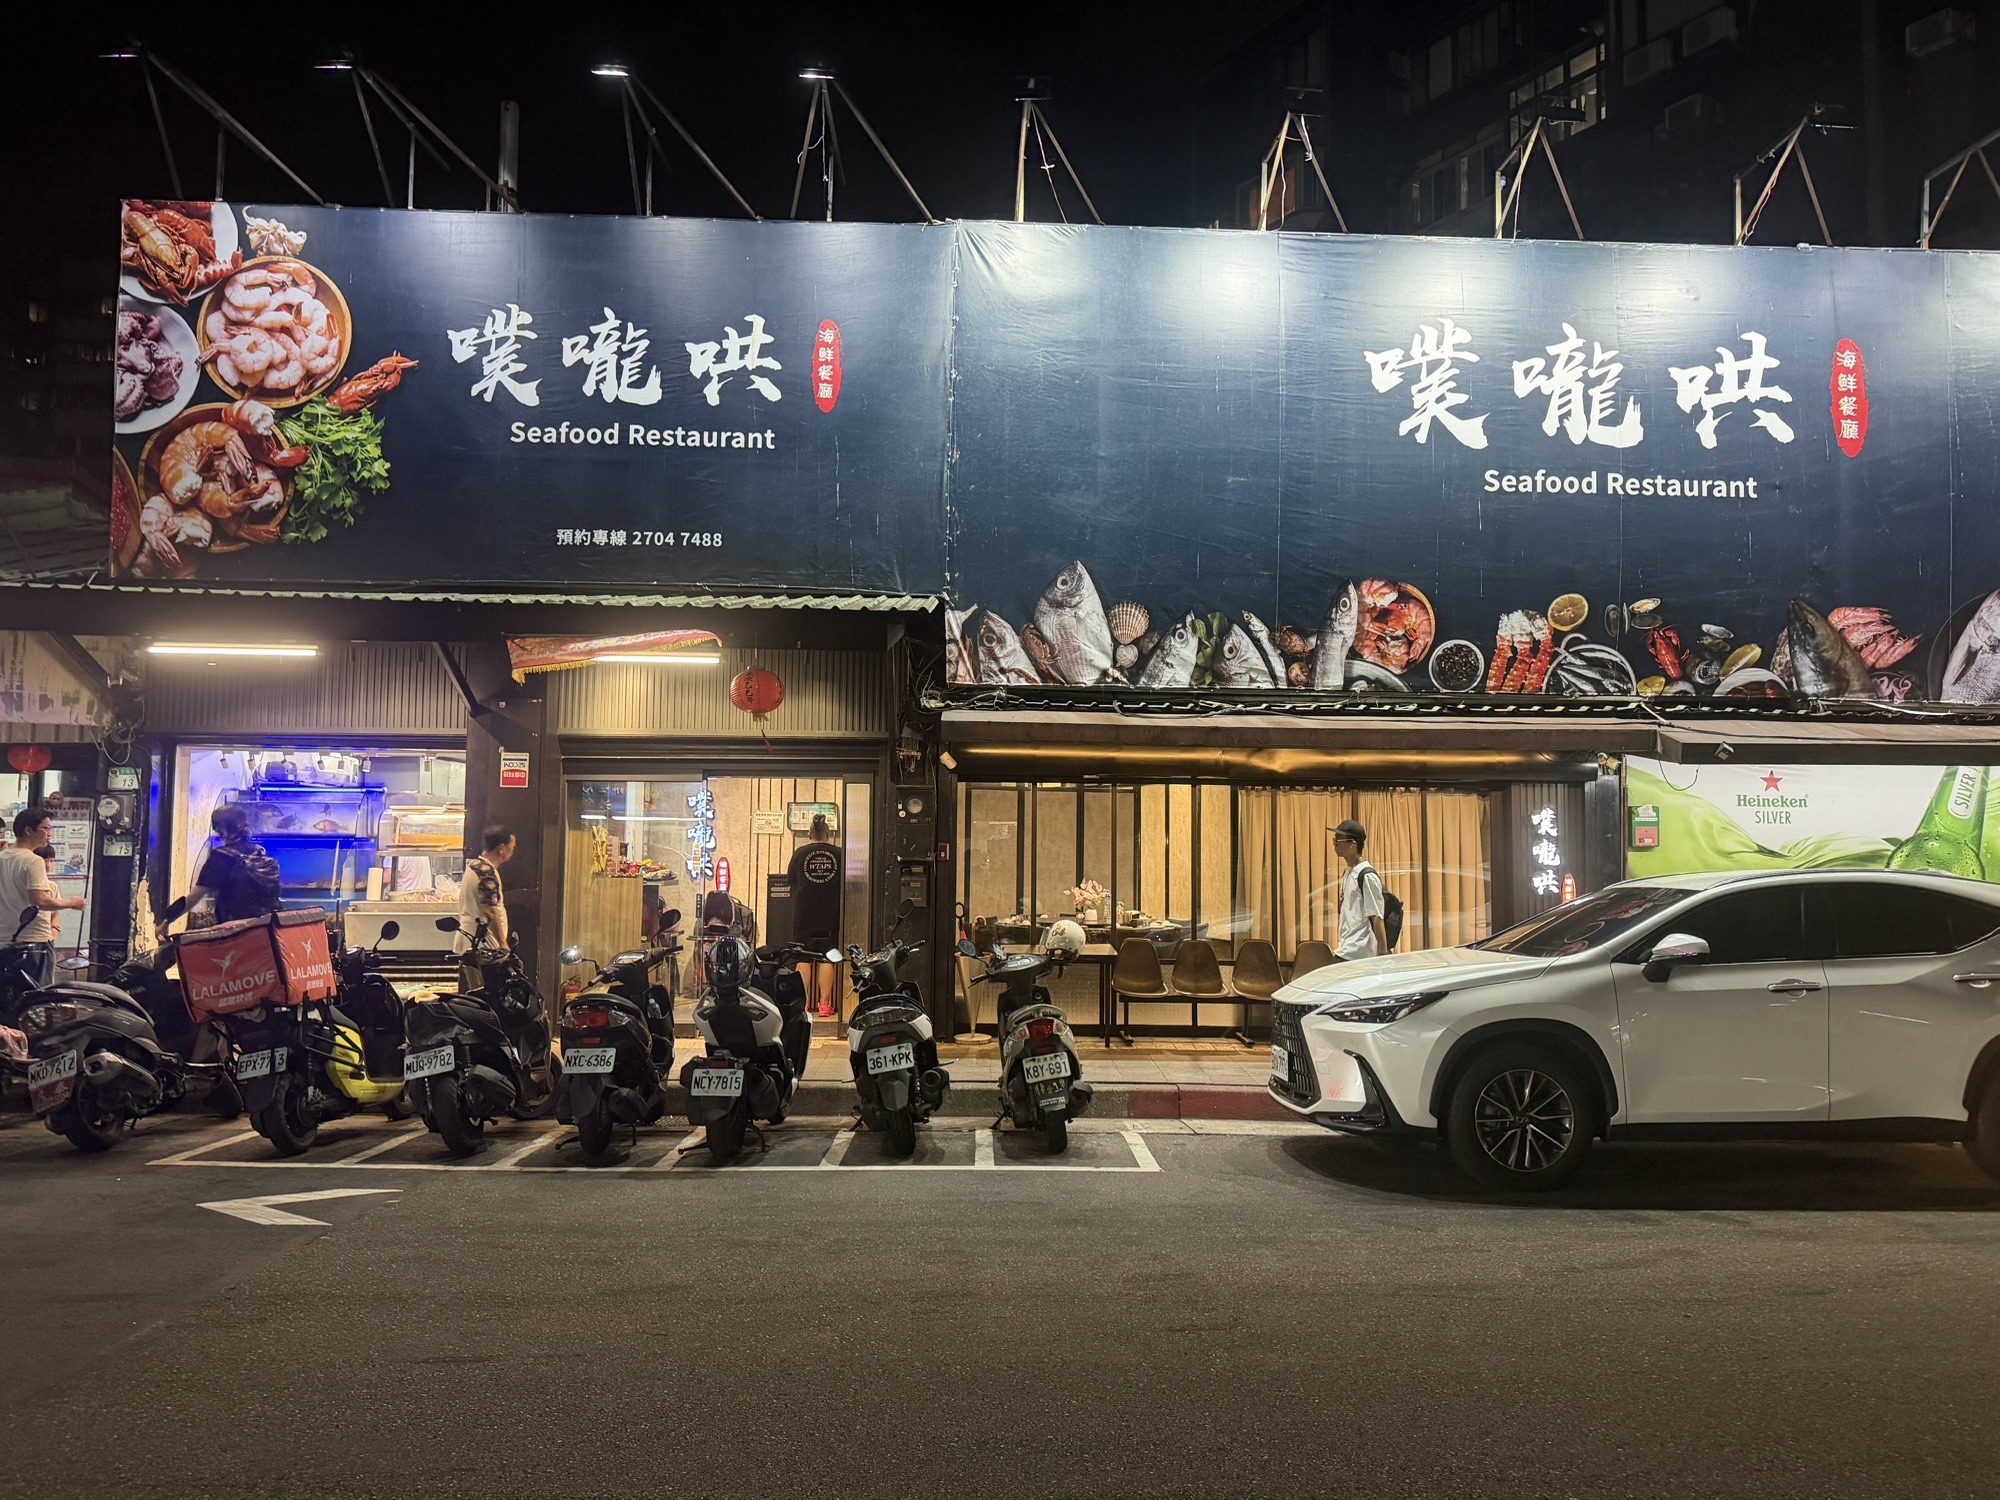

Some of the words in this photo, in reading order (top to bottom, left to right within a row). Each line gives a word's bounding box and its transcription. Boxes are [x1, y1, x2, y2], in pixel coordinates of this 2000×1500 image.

[447, 303, 782, 407] 噗嚨哄
[817, 328, 835, 399] 海鮮餐廳
[1365, 318, 1795, 449] 噗嚨哄
[1836, 350, 1859, 440] 海鮮餐廳
[510, 421, 620, 445] Seafood
[628, 424, 776, 450] Restaurant
[1483, 469, 1598, 495] Seafood
[1607, 472, 1758, 498] Restaurant
[556, 528, 627, 547] 預約專線
[632, 531, 675, 546] 2704
[680, 531, 723, 547] 7488
[122, 778, 134, 787] 13
[1954, 773, 1977, 810] SILVER
[1736, 794, 1809, 809] Heineken
[1754, 810, 1792, 825] SILVER
[118, 845, 130, 854] 15
[290, 963, 333, 980] LALAMOVE
[192, 969, 276, 1000] LALAMOVE
[238, 1053, 285, 1074] EPX-773
[405, 1052, 452, 1074] MUQ-9782
[565, 1054, 612, 1068] NXC-6386
[869, 1051, 912, 1071] 361-KPK
[1025, 1060, 1069, 1080] K8Y-691
[693, 1075, 741, 1091] NCY-7815
